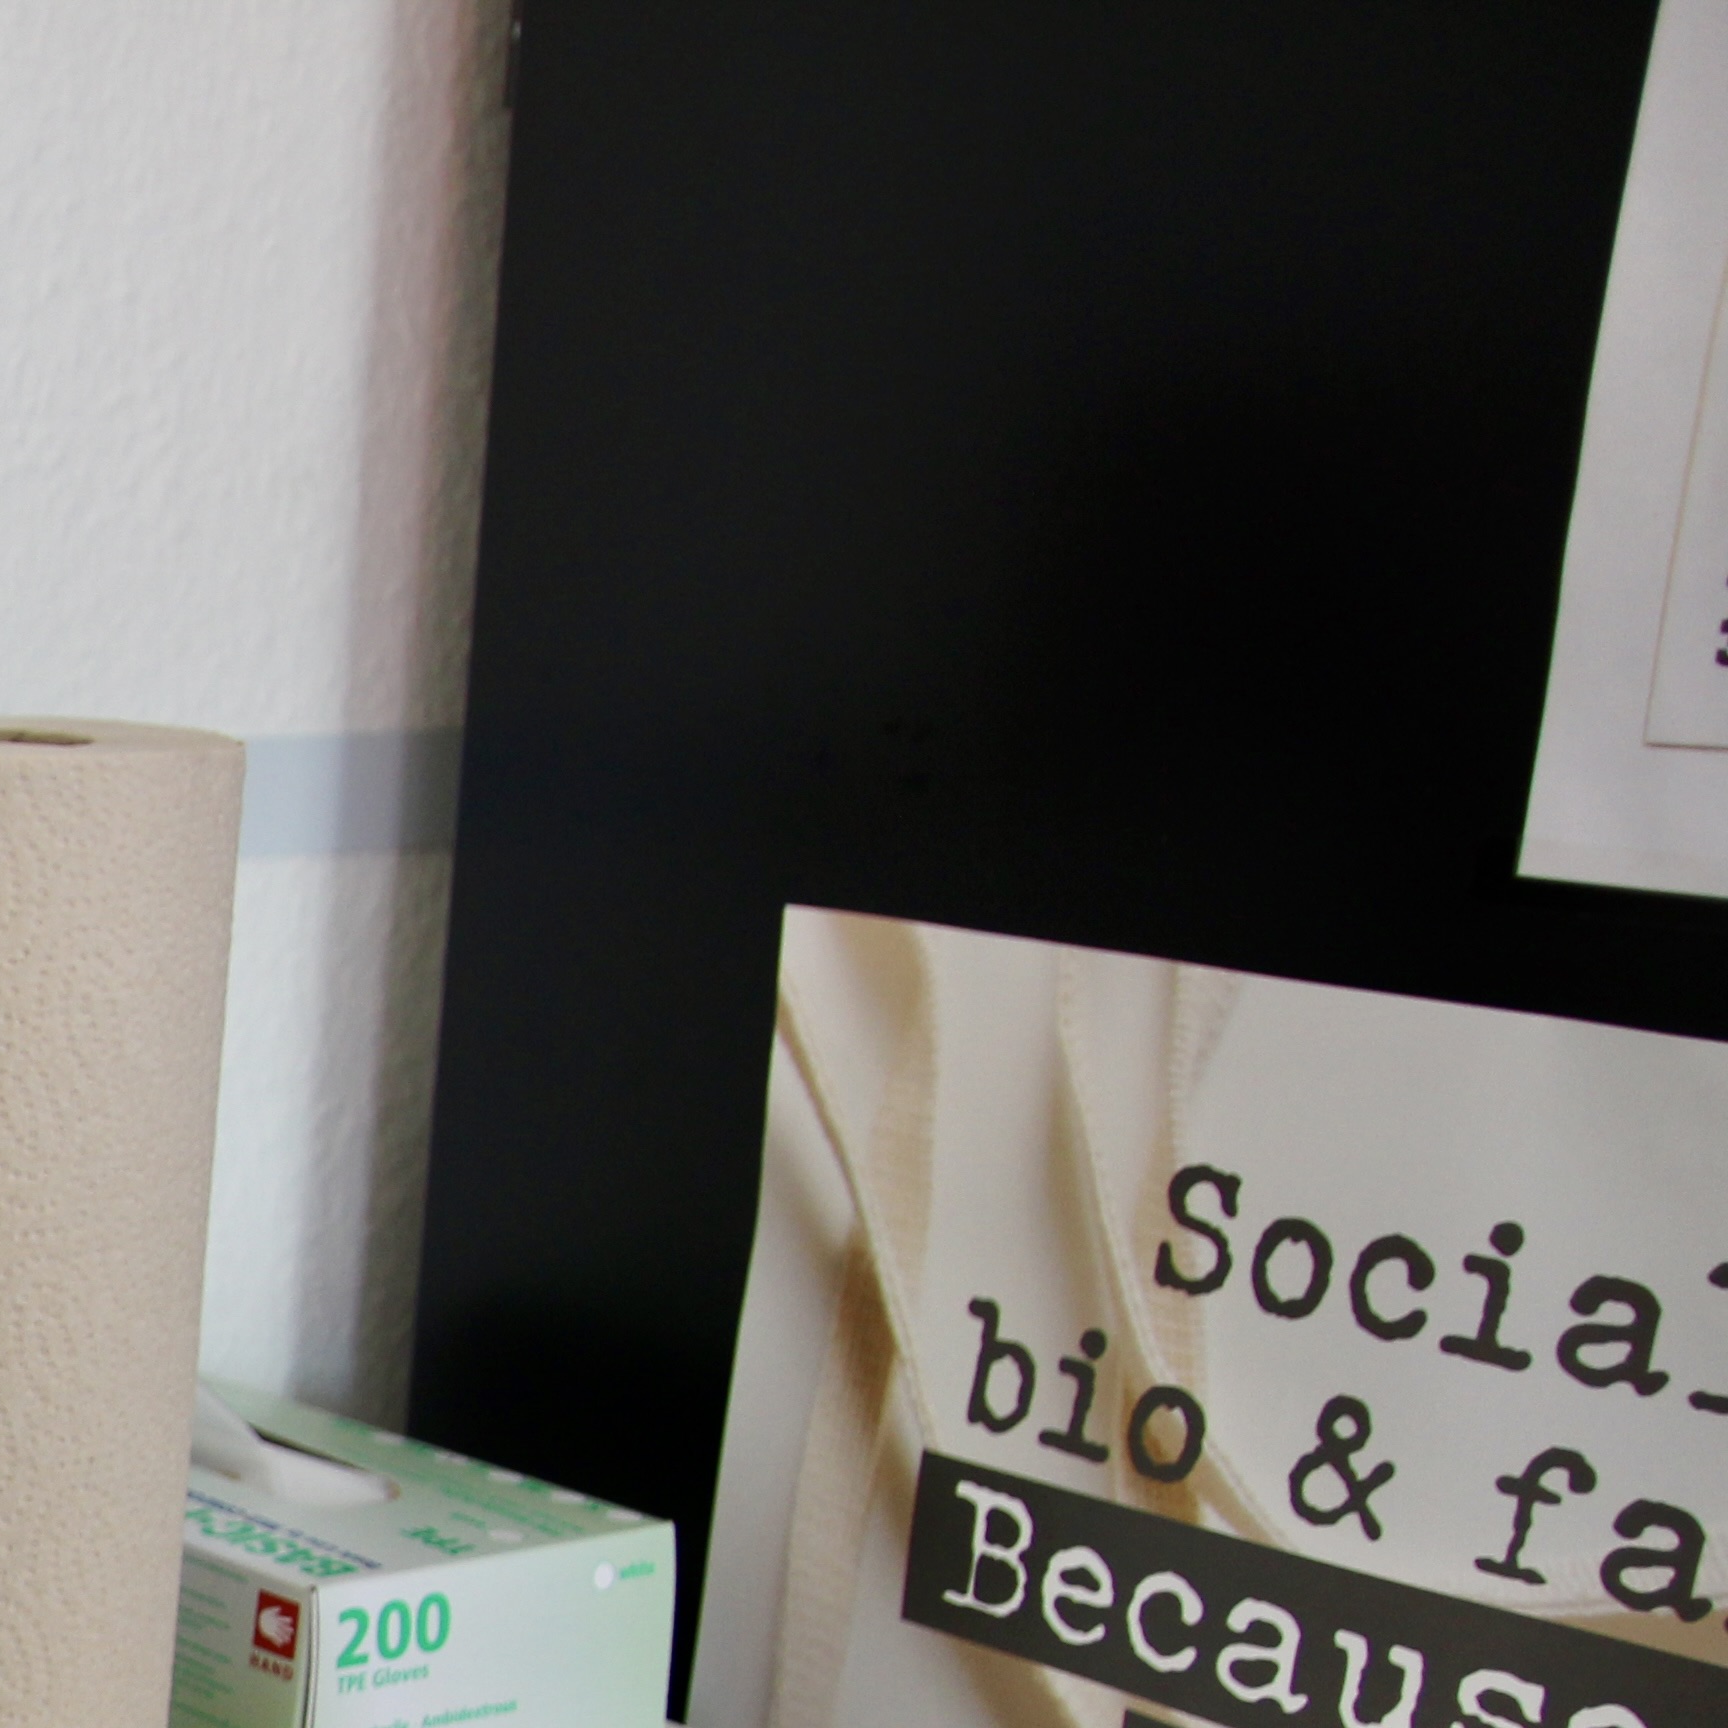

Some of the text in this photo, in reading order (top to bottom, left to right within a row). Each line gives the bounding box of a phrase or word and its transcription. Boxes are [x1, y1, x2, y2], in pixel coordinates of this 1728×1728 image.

[968, 1297, 1728, 1623] bio & fa
[335, 1592, 452, 1670] 200
[372, 1664, 430, 1689] Gloves
